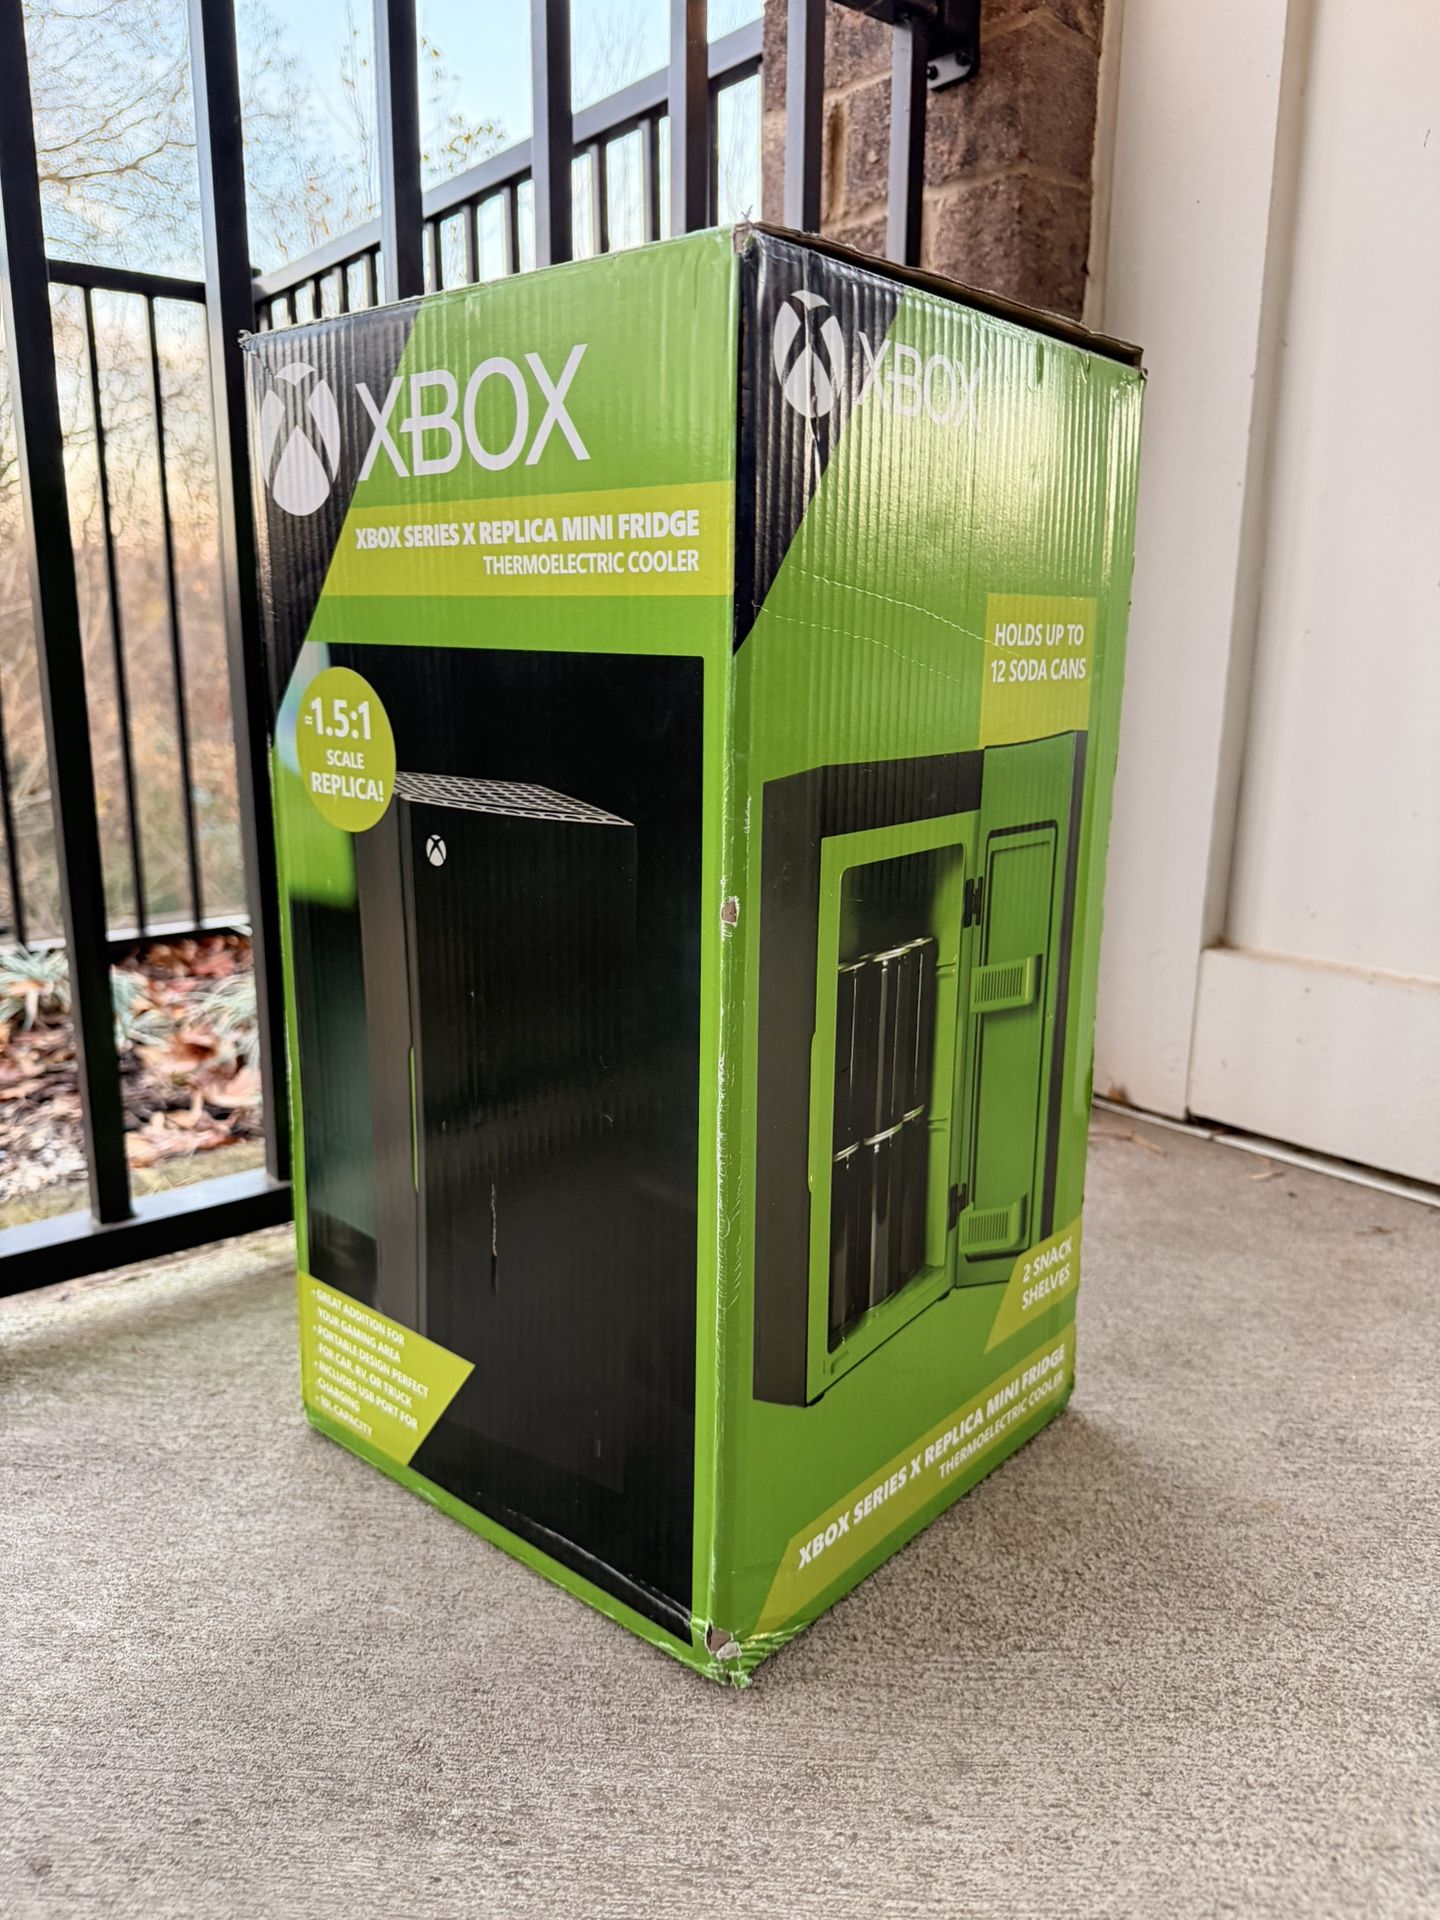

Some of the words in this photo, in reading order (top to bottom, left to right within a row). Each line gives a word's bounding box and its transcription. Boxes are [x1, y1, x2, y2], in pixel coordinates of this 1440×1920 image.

[856, 329, 981, 434] XBOX
[355, 343, 591, 483] XBOX
[355, 526, 402, 549] XBOX
[403, 523, 460, 547] SERIES
[462, 521, 477, 545] X
[478, 518, 559, 545] REPLICA
[562, 514, 614, 541] MINI
[618, 509, 700, 539] FRIDGE
[483, 552, 624, 575] THERMOELECTRIC
[627, 549, 700, 573] COOLER
[995, 623, 1043, 647] HOLDS
[1046, 624, 1065, 646] UP
[1067, 624, 1085, 646] TO
[991, 659, 1007, 683] 12
[1008, 659, 1048, 682] SODA
[1050, 657, 1087, 680] CANS
[326, 749, 365, 770] SCALE
[310, 771, 385, 802] REPLICA!
[1022, 1263, 1033, 1283] 2
[1033, 1236, 1073, 1274] SNACK
[1022, 1263, 1071, 1311] SHELVES
[316, 1289, 342, 1310] GREAT
[343, 1304, 386, 1336] ADDITION
[386, 1327, 406, 1346] FOR
[317, 1307, 340, 1328] YOUR
[341, 1320, 377, 1349] GAMING
[377, 1342, 401, 1363] AREA
[318, 1342, 335, 1361] FOR
[368, 1374, 382, 1389] OR
[383, 1380, 413, 1408] TRUCK
[359, 1348, 391, 1375] DESIGN
[391, 1367, 429, 1398] PERFECT
[375, 1395, 399, 1417] PORT
[399, 1410, 419, 1431] FOR
[938, 1402, 1027, 1480] THERMOELECTRIC
[1029, 1369, 1064, 1409] COOLER
[798, 1510, 851, 1570] XBOX
[853, 1465, 908, 1525] SERIES
[909, 1453, 922, 1480] X
[924, 1406, 984, 1468] REPLICA
[986, 1377, 1020, 1420] MINI
[1021, 1343, 1066, 1392] FRIDGE
